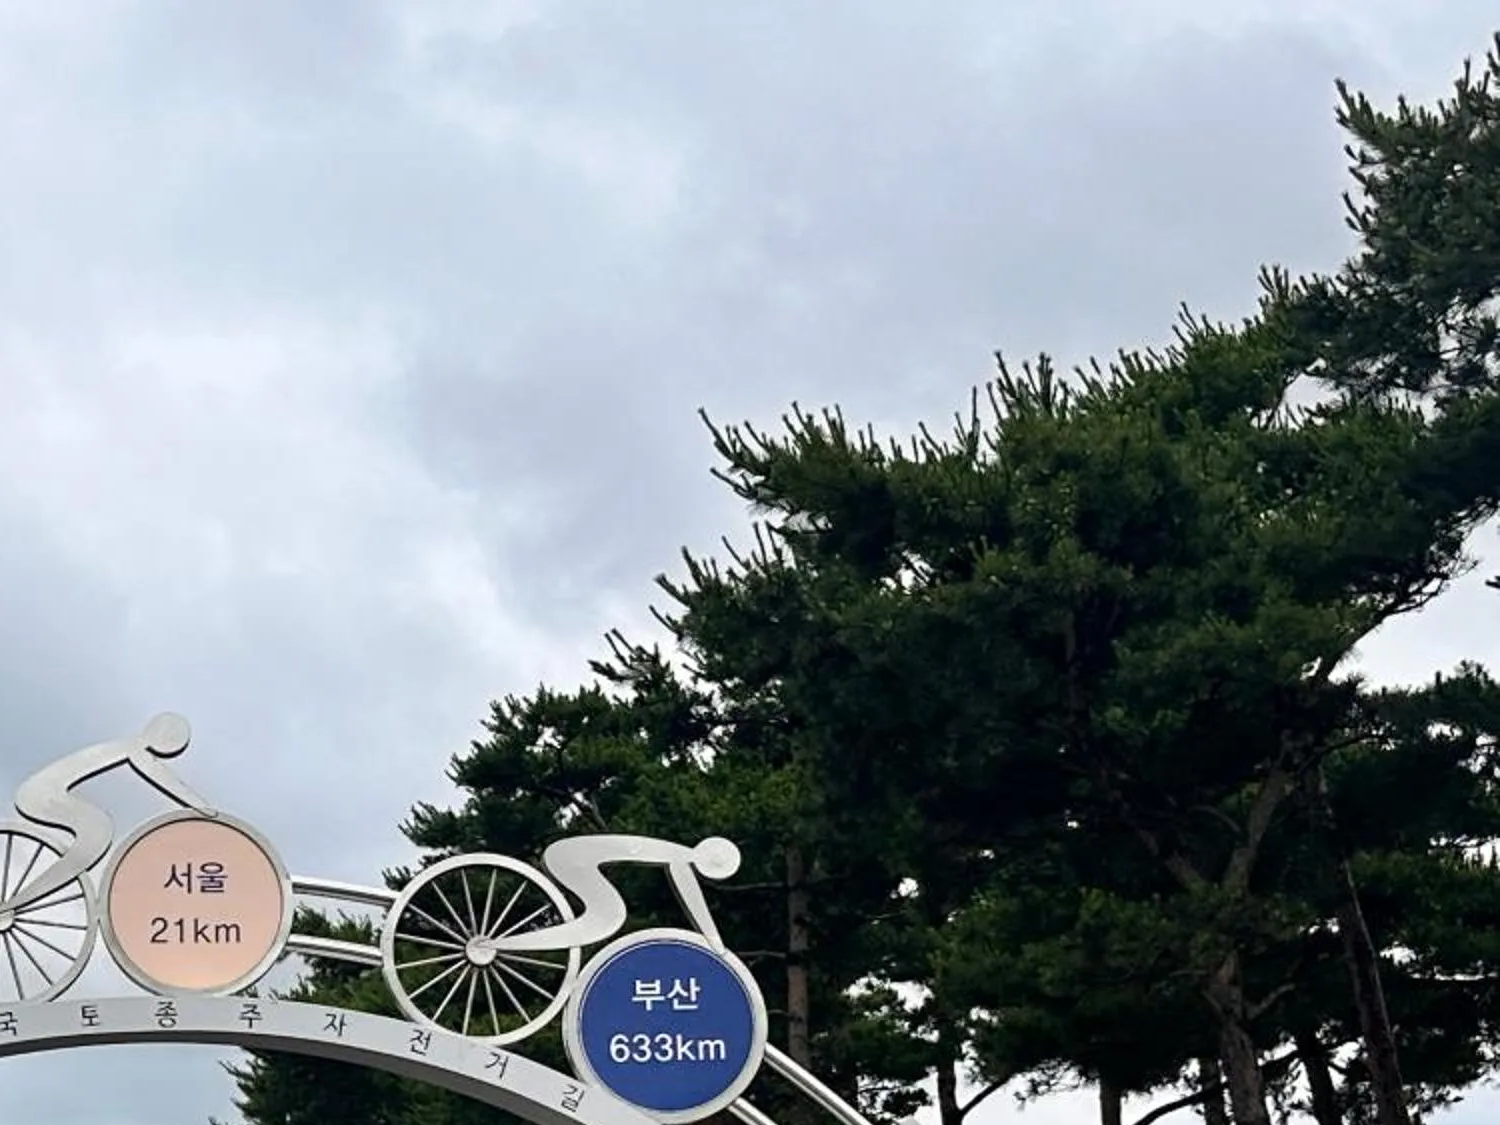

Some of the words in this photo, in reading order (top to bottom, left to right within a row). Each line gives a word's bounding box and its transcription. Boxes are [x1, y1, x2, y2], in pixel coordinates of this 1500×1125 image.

[163, 861, 228, 895] 서울
[150, 917, 241, 943] 21km
[631, 977, 701, 1011] 부산
[609, 1033, 726, 1063] 633km
